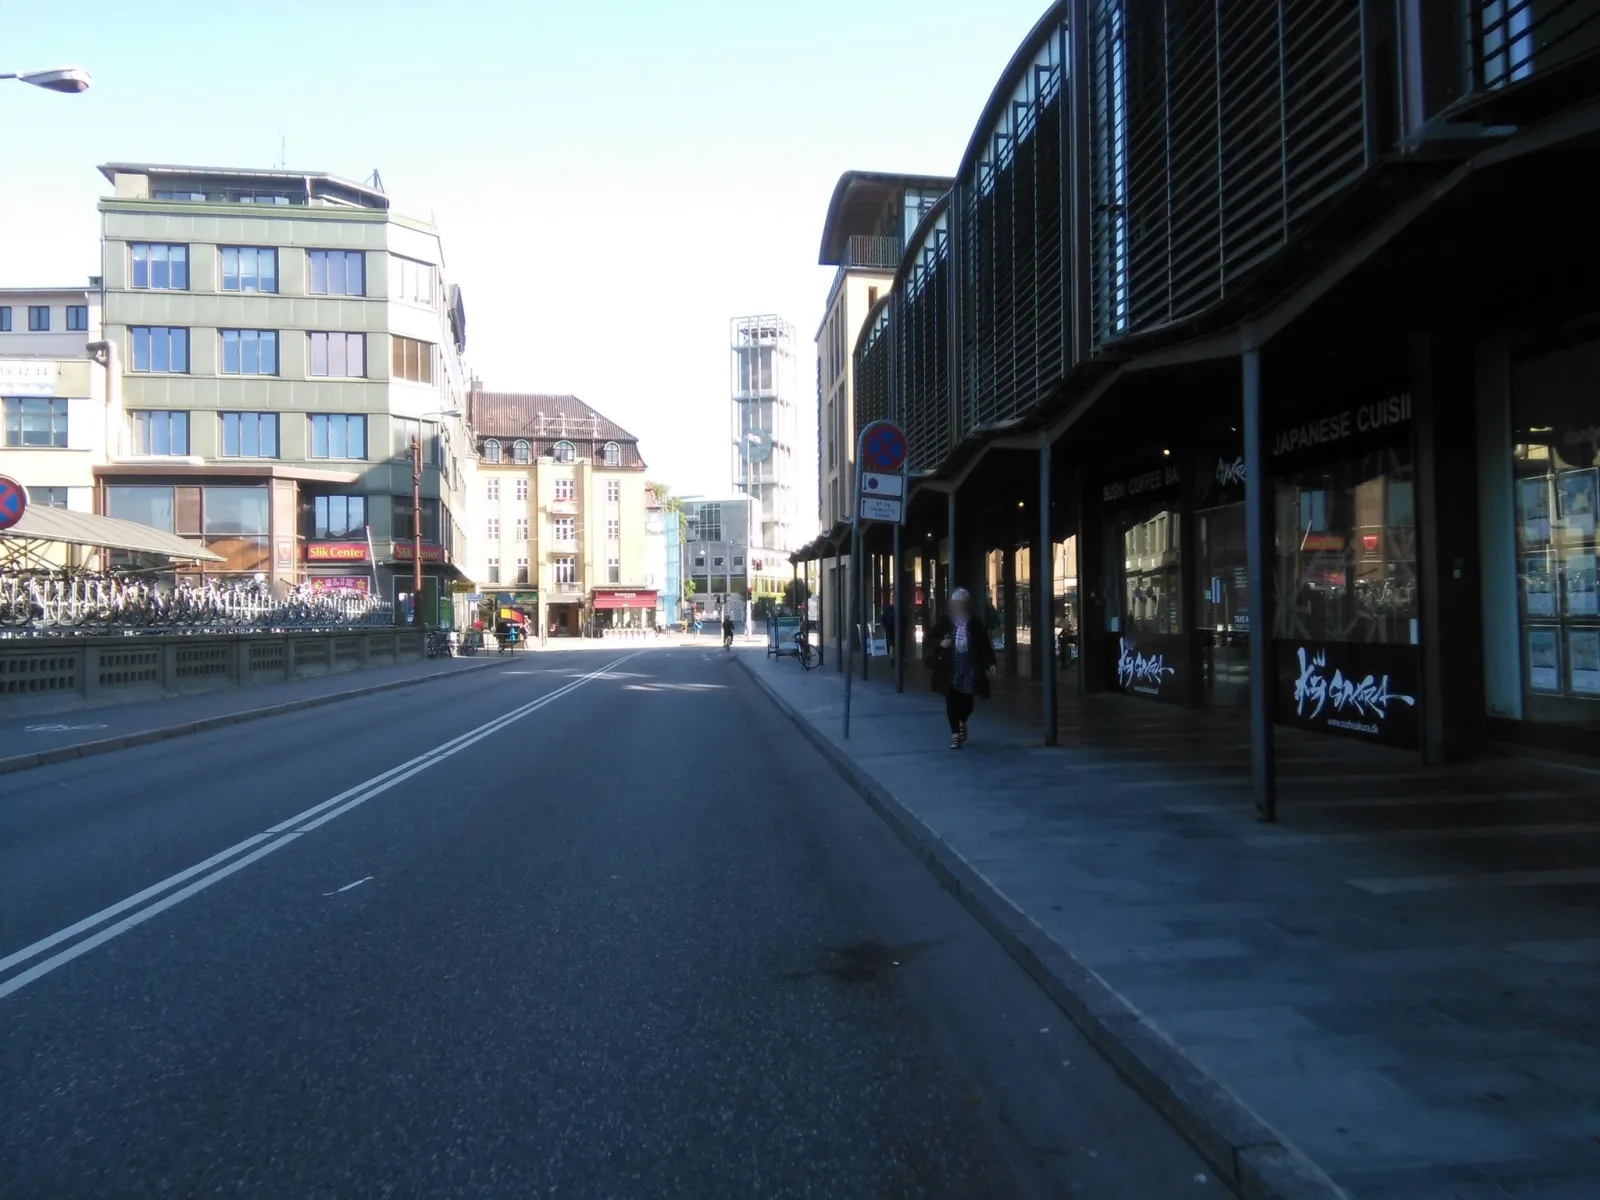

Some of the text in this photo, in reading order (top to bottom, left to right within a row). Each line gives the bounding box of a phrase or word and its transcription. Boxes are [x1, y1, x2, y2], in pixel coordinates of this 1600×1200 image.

[1271, 411, 1352, 457] JAPANESE
[1102, 481, 1125, 502] SUSHI
[1128, 468, 1163, 495] COFFEE
[1164, 464, 1180, 486] BA
[310, 547, 365, 558] Slik Center
[325, 577, 354, 587] SLIK
